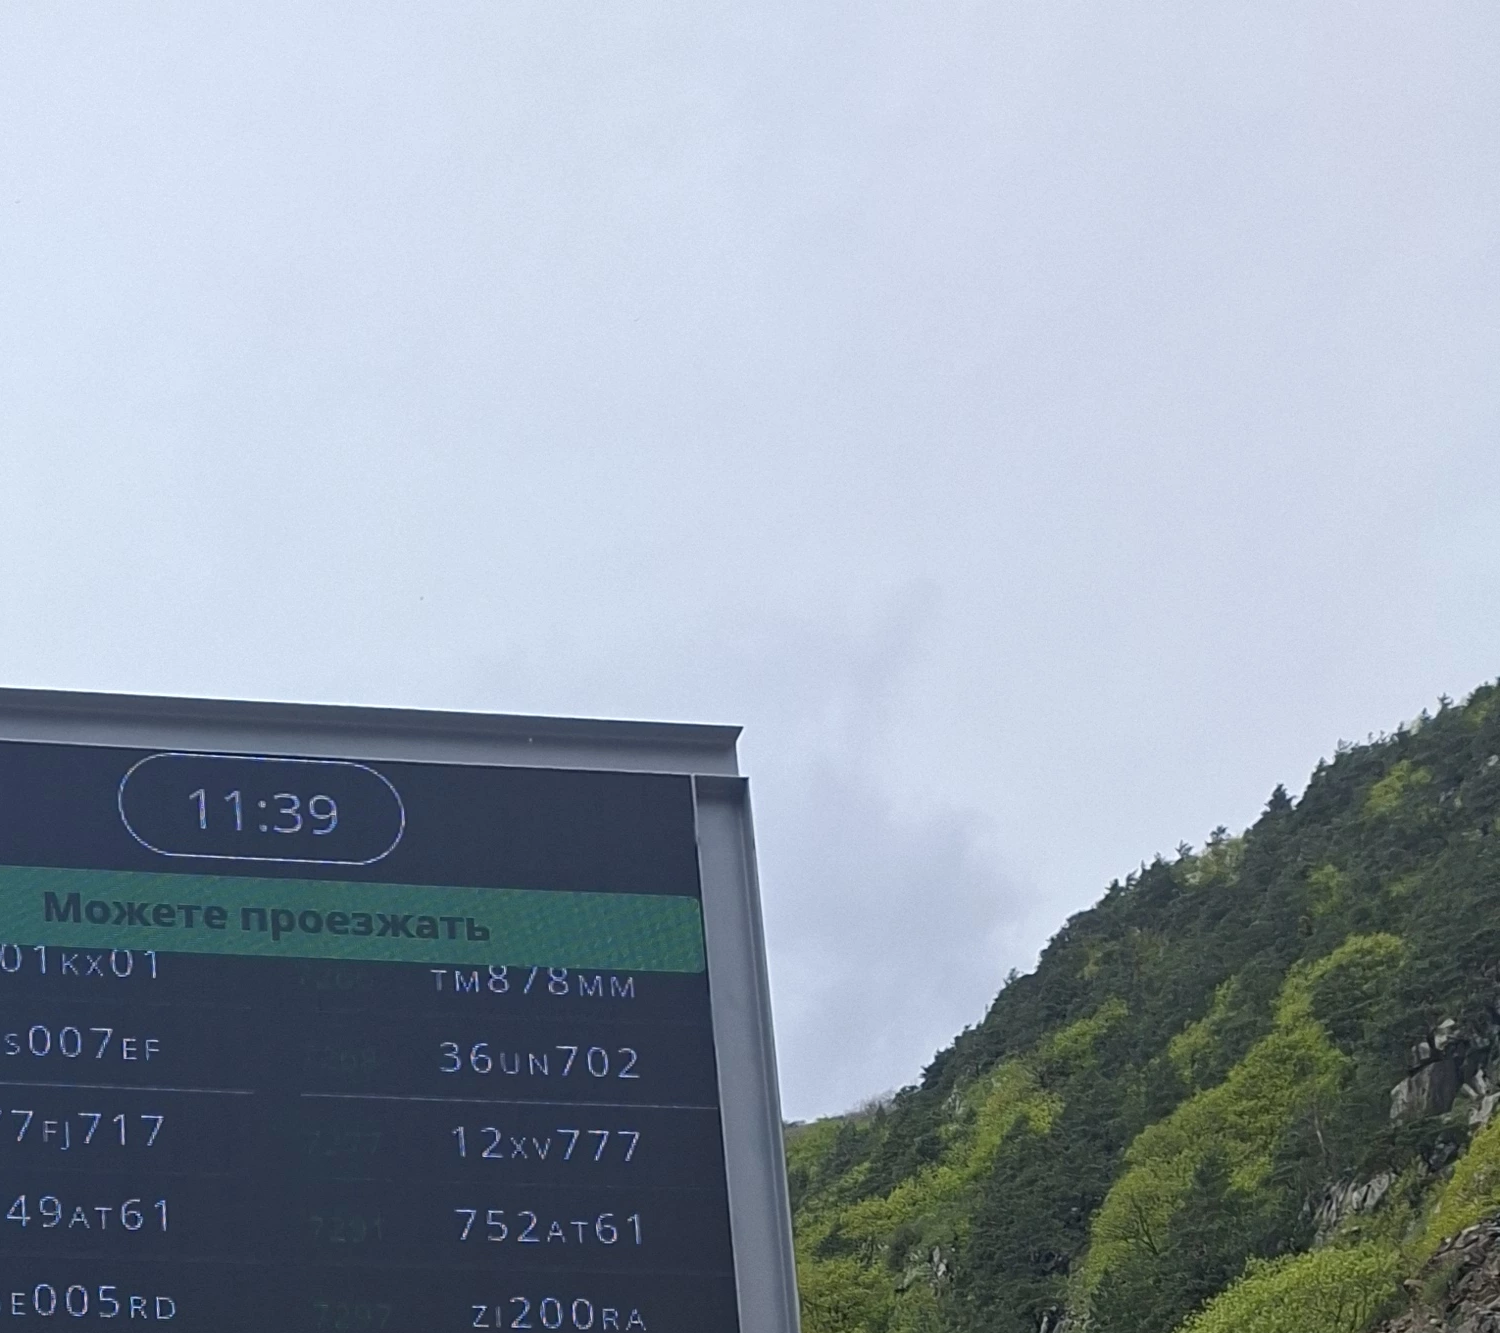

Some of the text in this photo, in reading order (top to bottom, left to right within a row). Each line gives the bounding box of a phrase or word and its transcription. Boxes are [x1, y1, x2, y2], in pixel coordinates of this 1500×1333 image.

[188, 788, 338, 835] 11:39
[43, 891, 490, 942] Можете проезжать
[439, 1041, 640, 1079] 36UN702
[452, 1126, 640, 1162] 12XV777
[454, 1208, 642, 1245] 752AT61
[471, 1296, 647, 1331] ZI200RA
